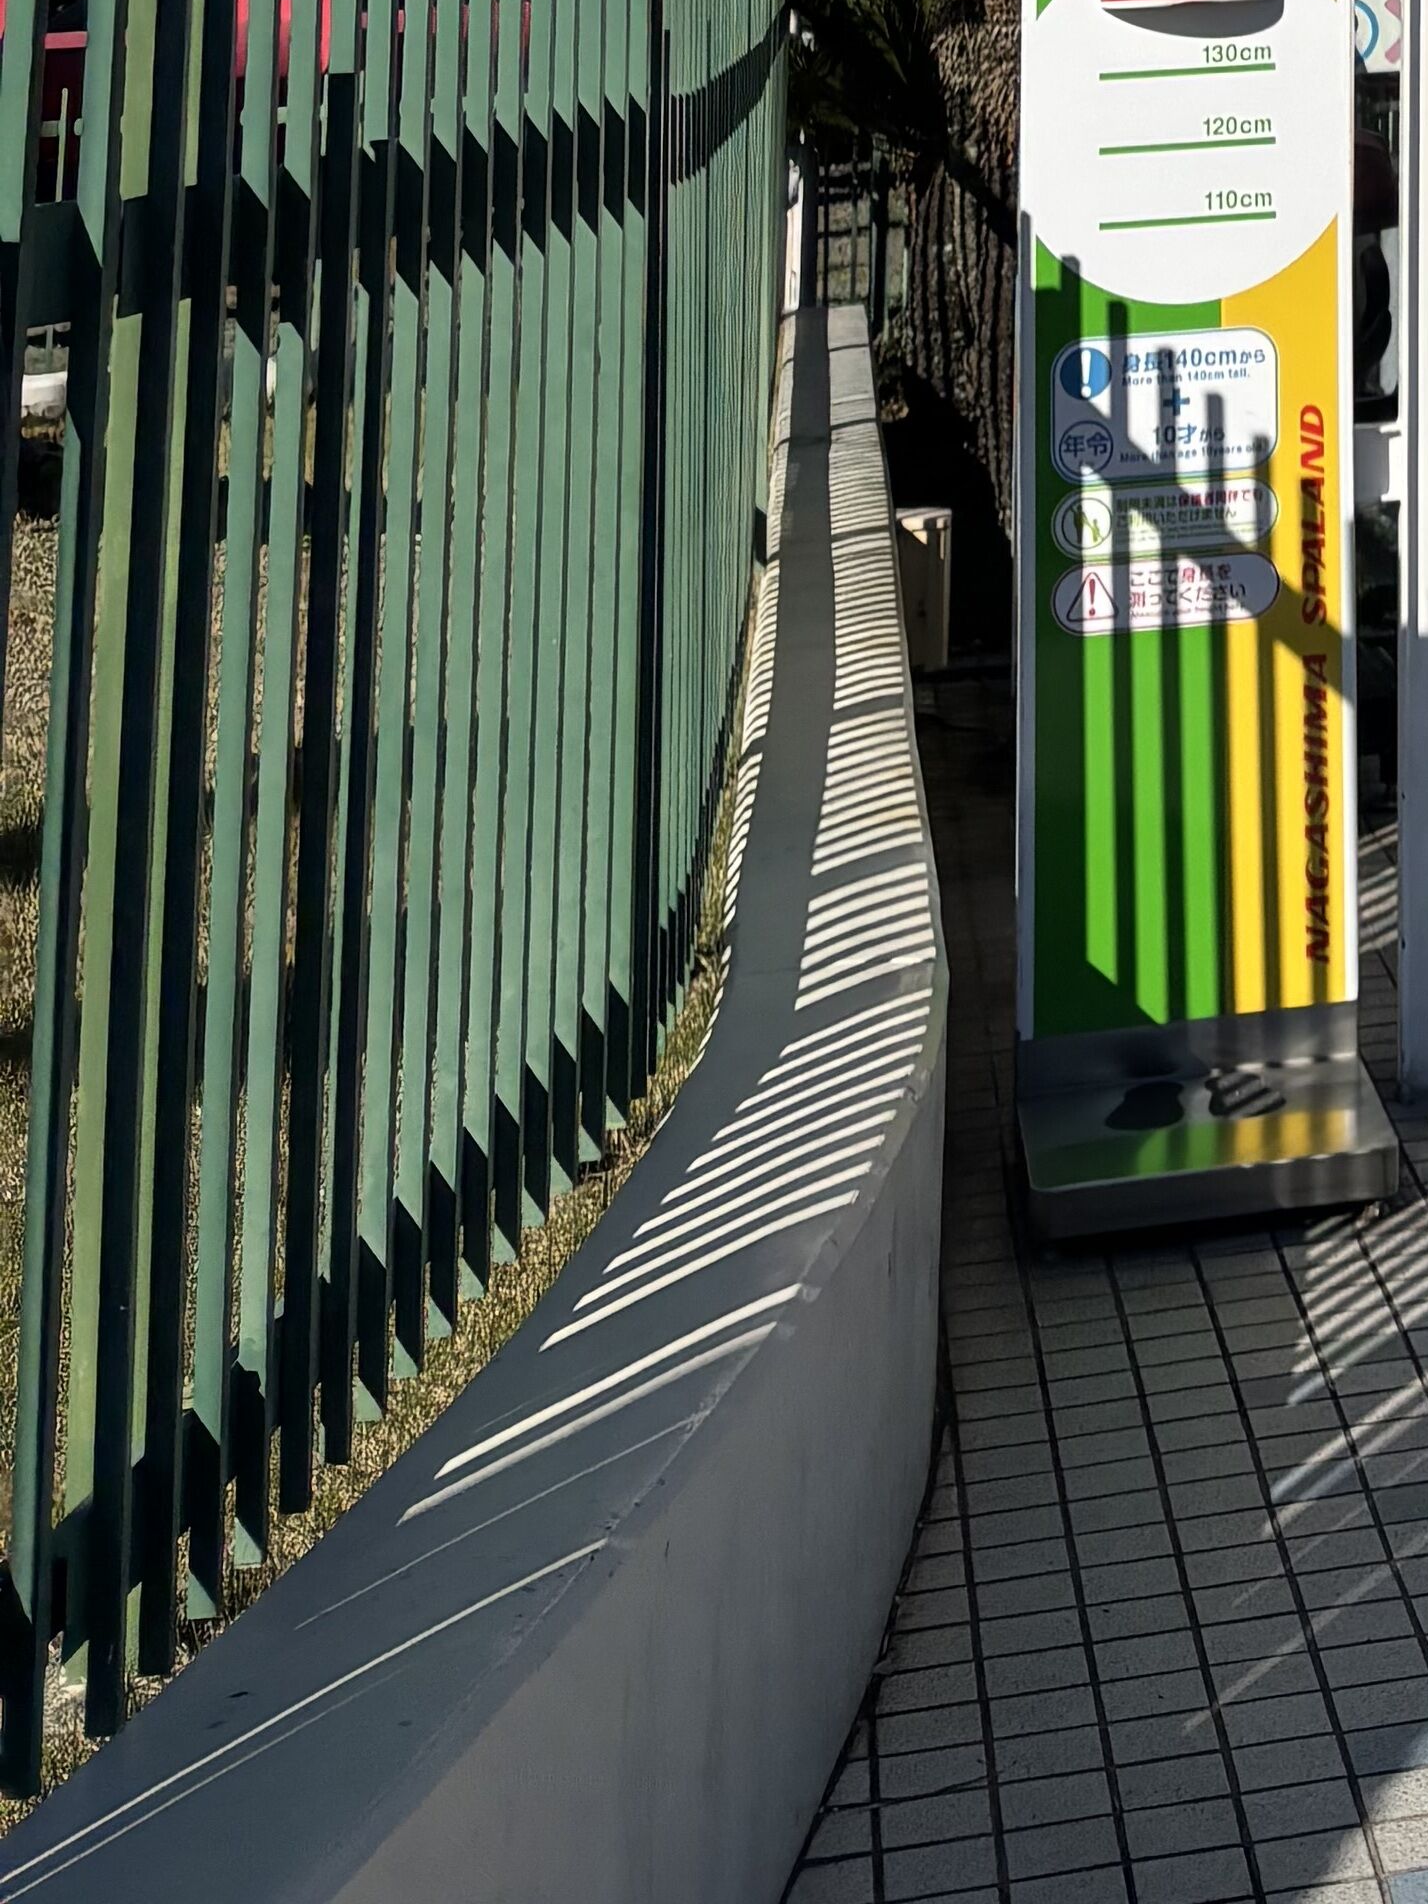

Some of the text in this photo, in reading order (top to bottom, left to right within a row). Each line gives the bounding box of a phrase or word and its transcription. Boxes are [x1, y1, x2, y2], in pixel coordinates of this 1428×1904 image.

[1202, 43, 1273, 64] 130cm
[1202, 117, 1273, 136] 120cm
[1204, 190, 1273, 211] 110cm
[1063, 431, 1110, 458] 年令
[1152, 422, 1225, 446] 10才から
[1299, 404, 1332, 963] NAGASHIMA SPALAND
